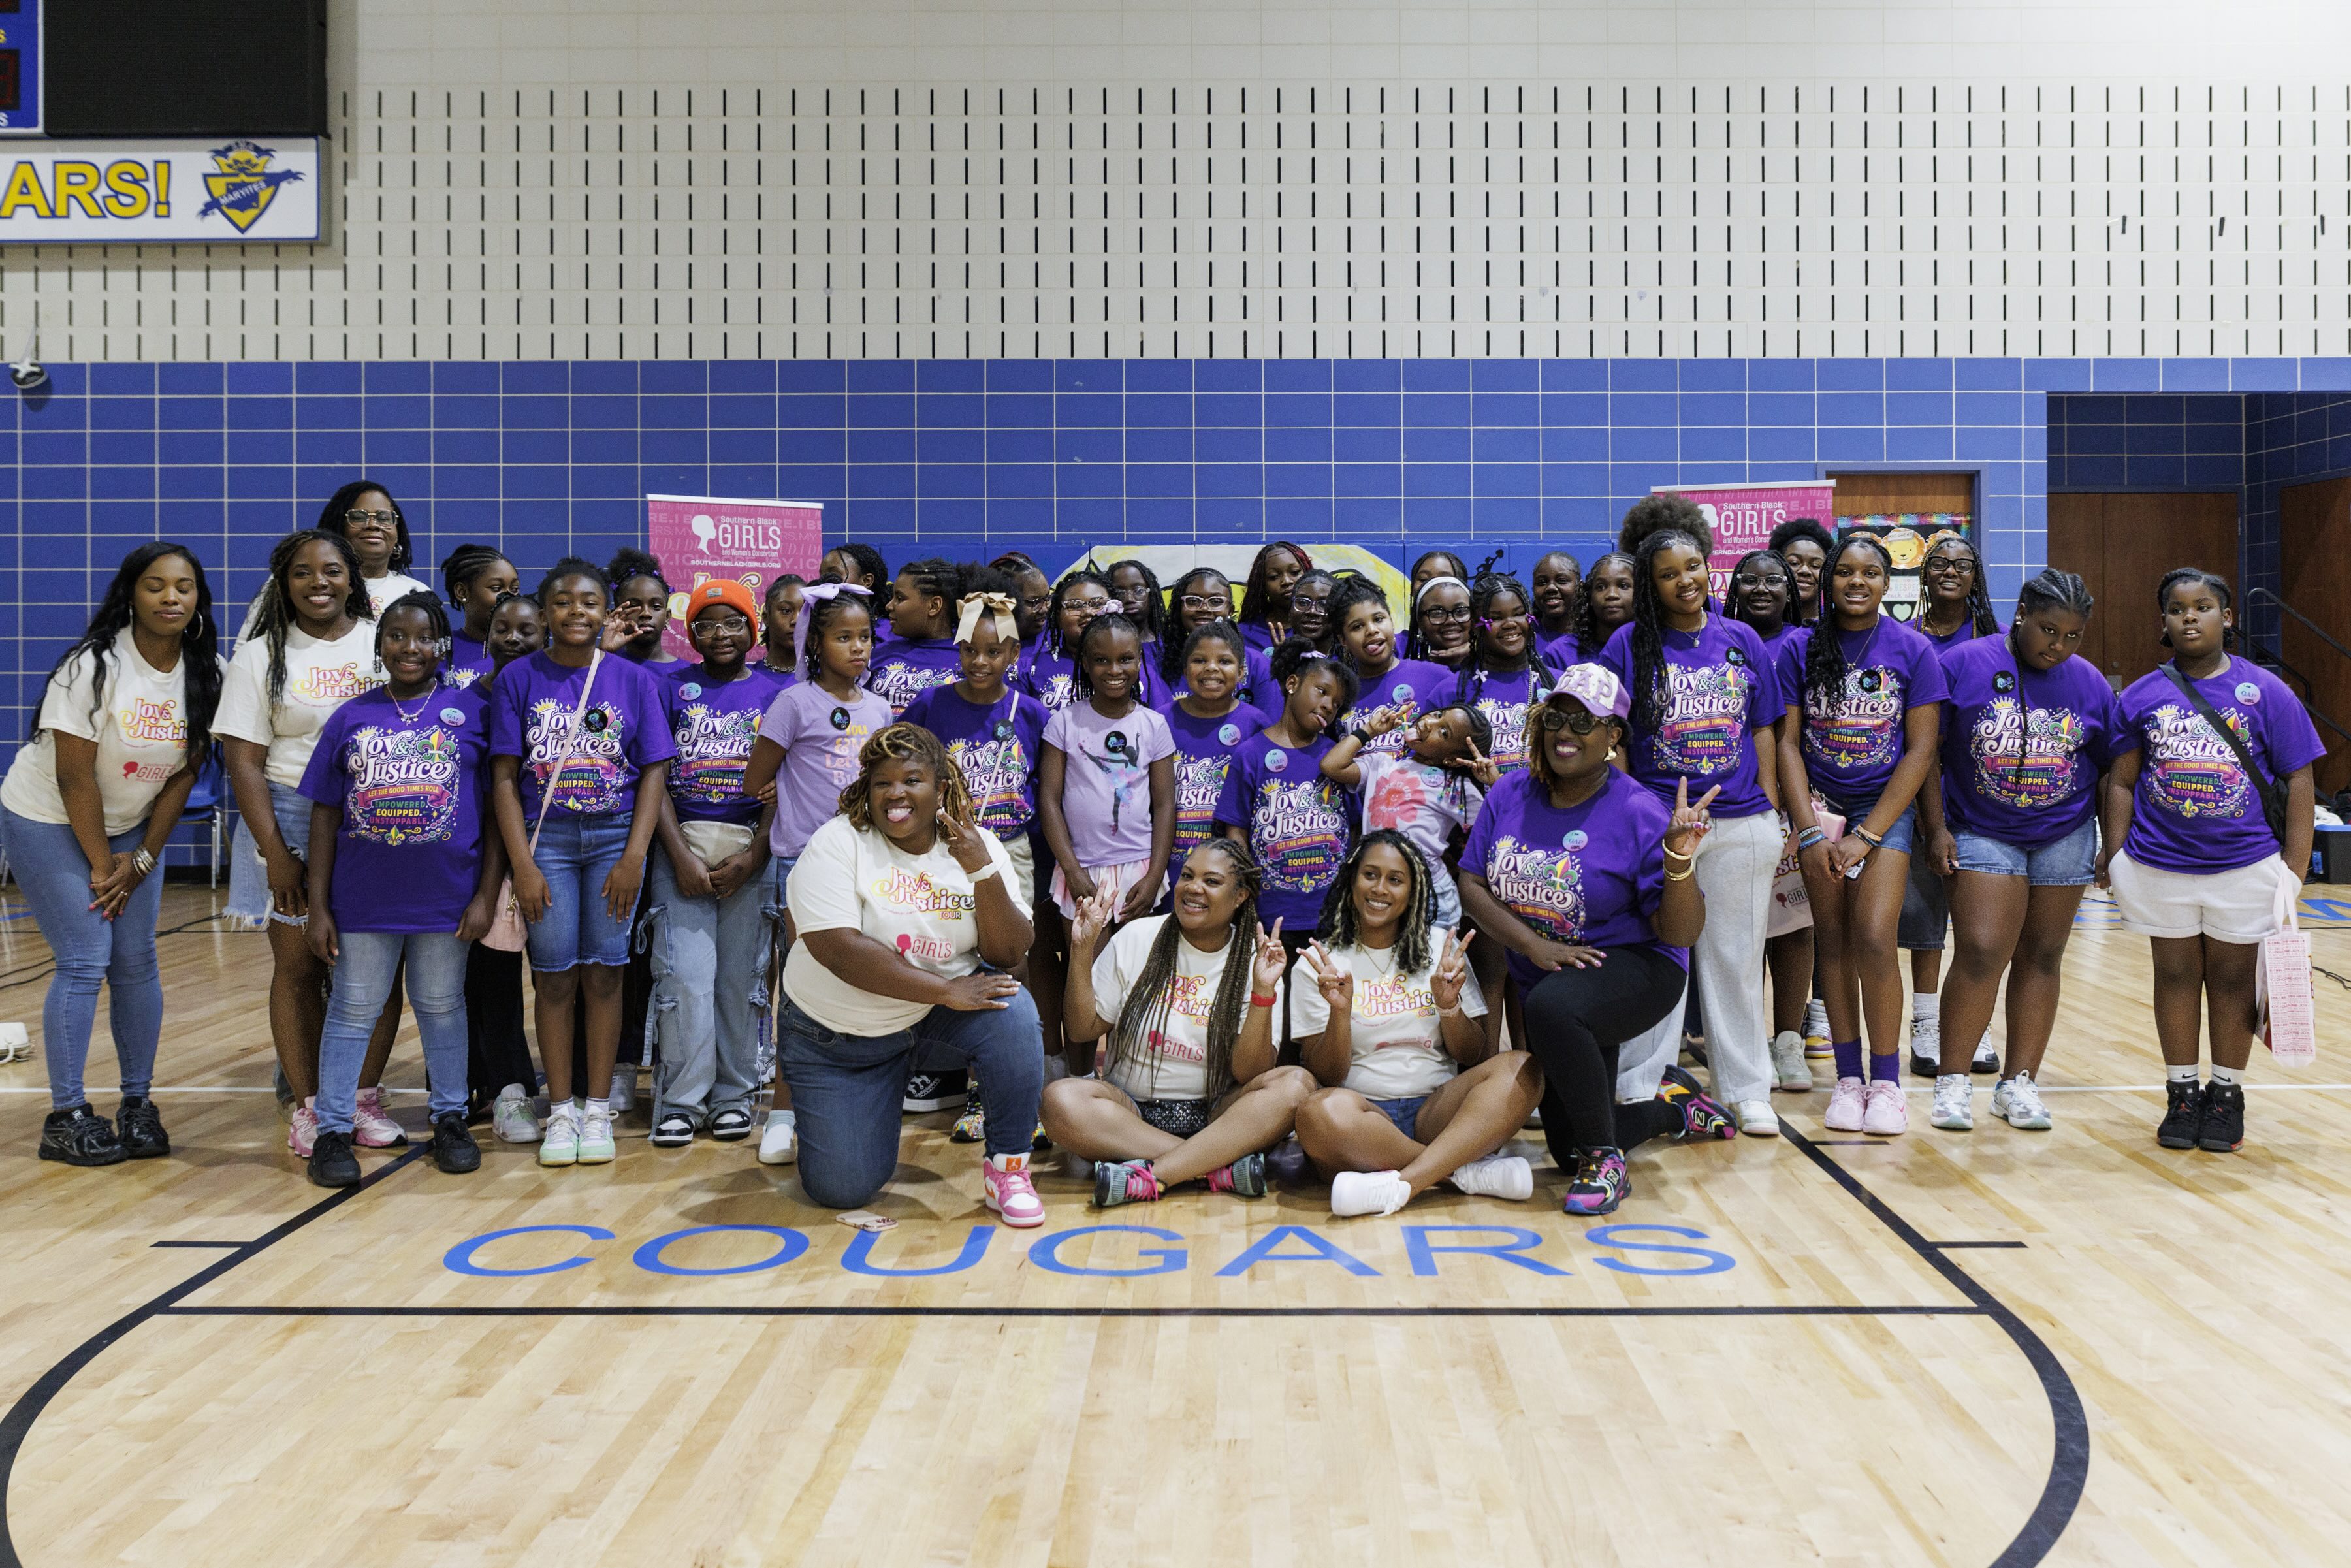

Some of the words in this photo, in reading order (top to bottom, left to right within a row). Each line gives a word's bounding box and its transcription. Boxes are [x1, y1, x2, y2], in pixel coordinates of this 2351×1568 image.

[0, 160, 170, 219] ARS!
[720, 515, 755, 524] Southern
[1720, 509, 1787, 536] GIRLS
[718, 524, 781, 550] GIRLS
[690, 560, 782, 568] SOUTHERNBLACKGIRLS.ORG
[293, 662, 358, 693] Joy
[873, 669, 933, 696] Joy
[914, 678, 925, 689] &
[1654, 667, 1713, 706] Joy
[1698, 678, 1710, 691] &
[1846, 682, 1859, 694] &
[120, 698, 176, 728] Joy
[1663, 692, 1744, 722] Justice
[675, 711, 741, 746] Joy
[723, 723, 736, 736] &
[2030, 721, 2043, 733] &
[2194, 722, 2207, 735] &
[350, 730, 416, 773] Joy
[395, 742, 409, 755] &
[530, 733, 620, 762] Jutice
[680, 736, 752, 761] Justic
[356, 756, 453, 790] Justice
[1195, 770, 1207, 783] &
[2219, 764, 2232, 773] ROLL
[1258, 781, 1313, 825] Joy
[1298, 795, 1310, 808] &
[1262, 809, 1342, 841] Justice
[1487, 848, 1547, 882] Joy
[1524, 861, 1536, 876] &
[872, 867, 934, 897] Joy
[920, 880, 932, 891] &
[1491, 874, 1575, 910] Justice
[888, 886, 976, 912] Justice
[938, 911, 961, 920] TOUR
[912, 939, 952, 959] GIRLS
[1352, 974, 1407, 1009] Joy
[1394, 984, 1405, 995] &
[1163, 1039, 1204, 1061] GIRLS
[441, 1224, 1738, 1277] COUGARS
